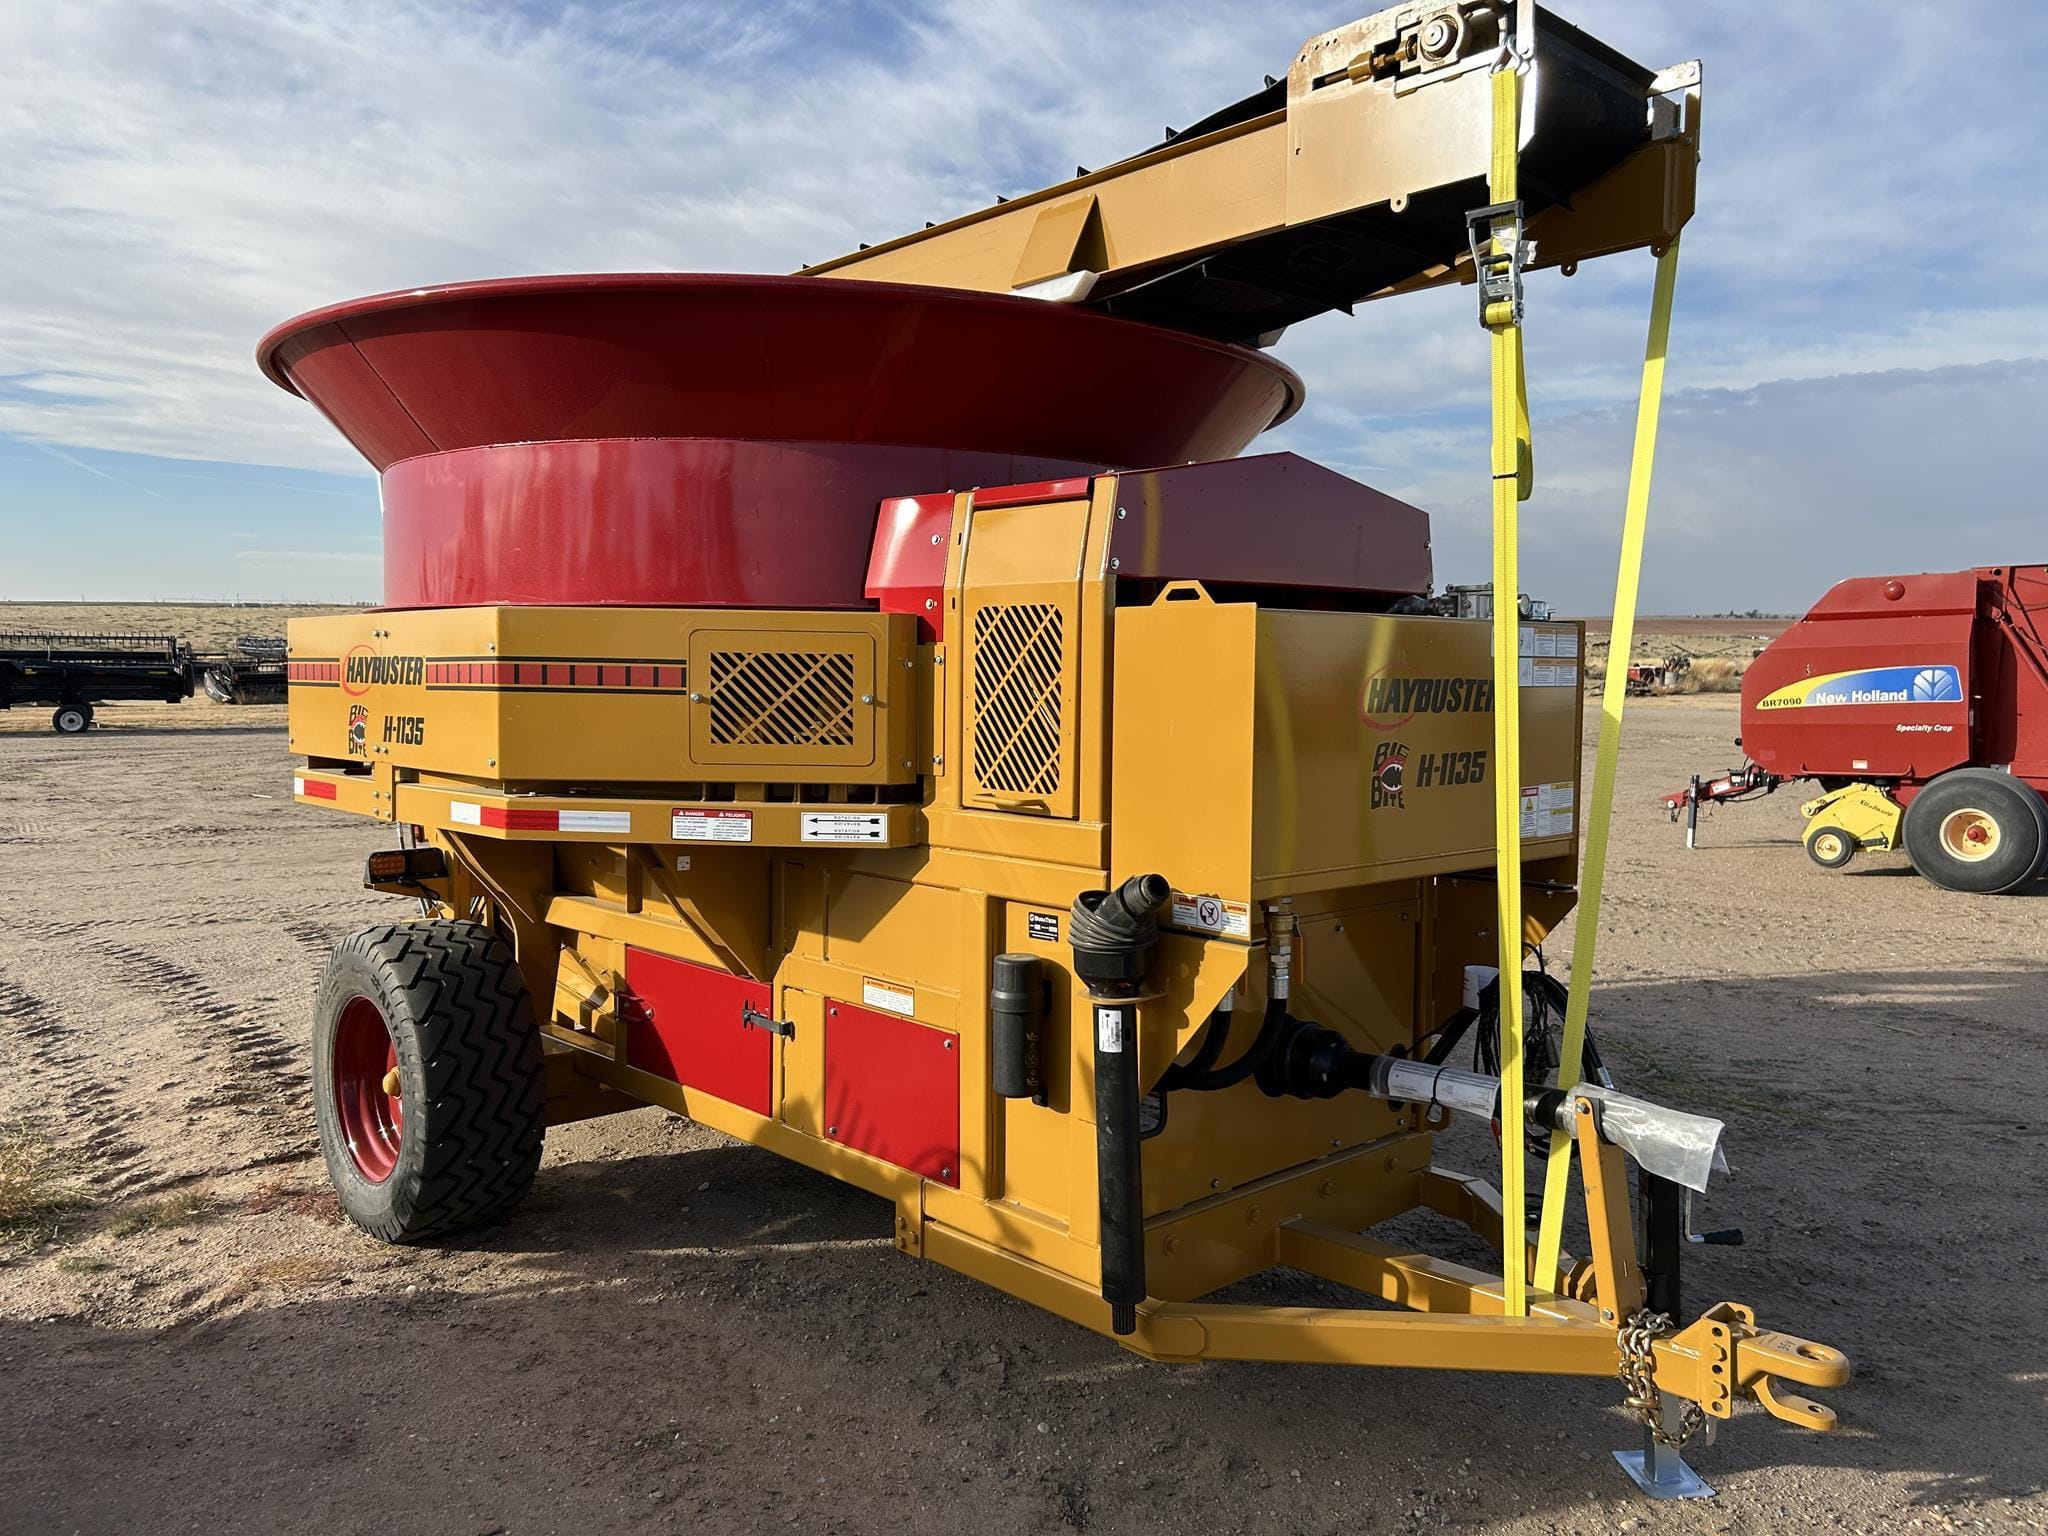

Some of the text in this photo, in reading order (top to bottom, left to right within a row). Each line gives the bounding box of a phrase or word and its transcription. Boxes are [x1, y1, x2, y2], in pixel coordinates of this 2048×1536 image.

[346, 655, 424, 686] HAYBUSTER
[1762, 697, 1802, 708] BR7090
[1815, 689, 1907, 704] New Holland
[383, 715, 425, 746] H-1135
[1896, 723, 1953, 733] Specialty Crop
[1372, 741, 1410, 773] BIG
[1416, 750, 1487, 788] H-1135
[1370, 774, 1406, 810] BITE
